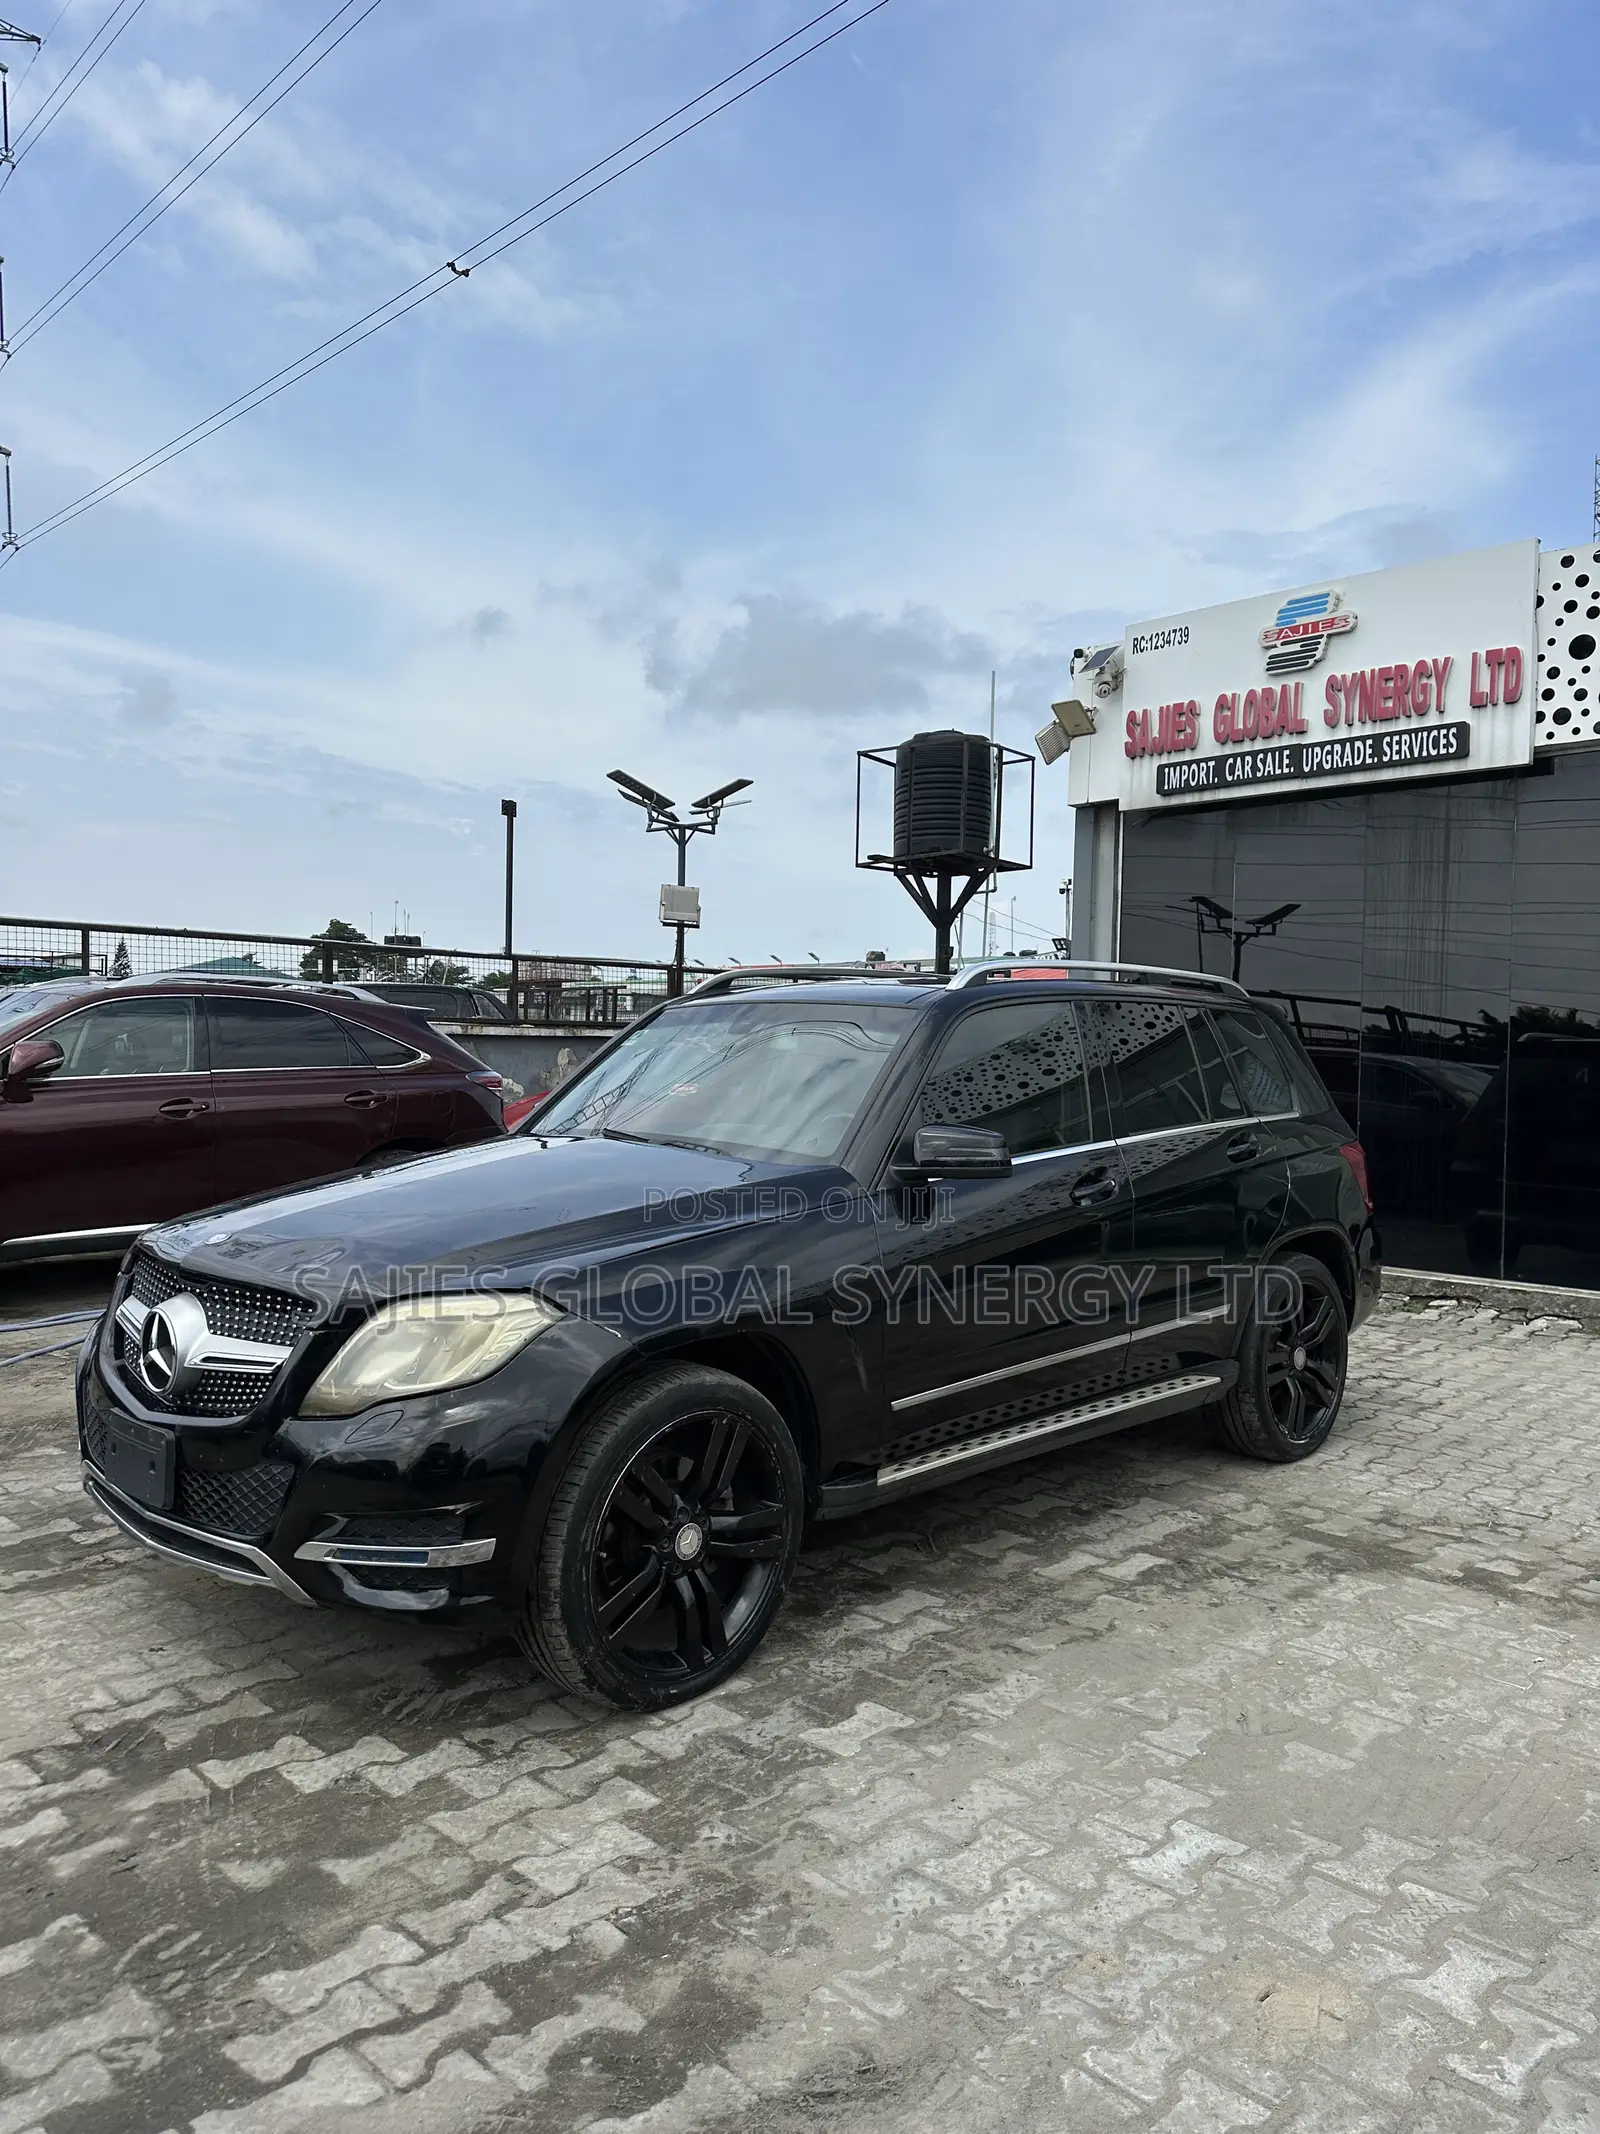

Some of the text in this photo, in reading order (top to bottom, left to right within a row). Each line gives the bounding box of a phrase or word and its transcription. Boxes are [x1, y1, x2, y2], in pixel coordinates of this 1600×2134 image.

[1132, 626, 1190, 655] RC:1234739
[1261, 614, 1350, 647] SAJIES
[1125, 646, 1525, 760] SAJIES GLOBAL SYNERGY LTD
[1163, 726, 1458, 790] IMPORT. CAR SALE. UPGRADE. SERVICES
